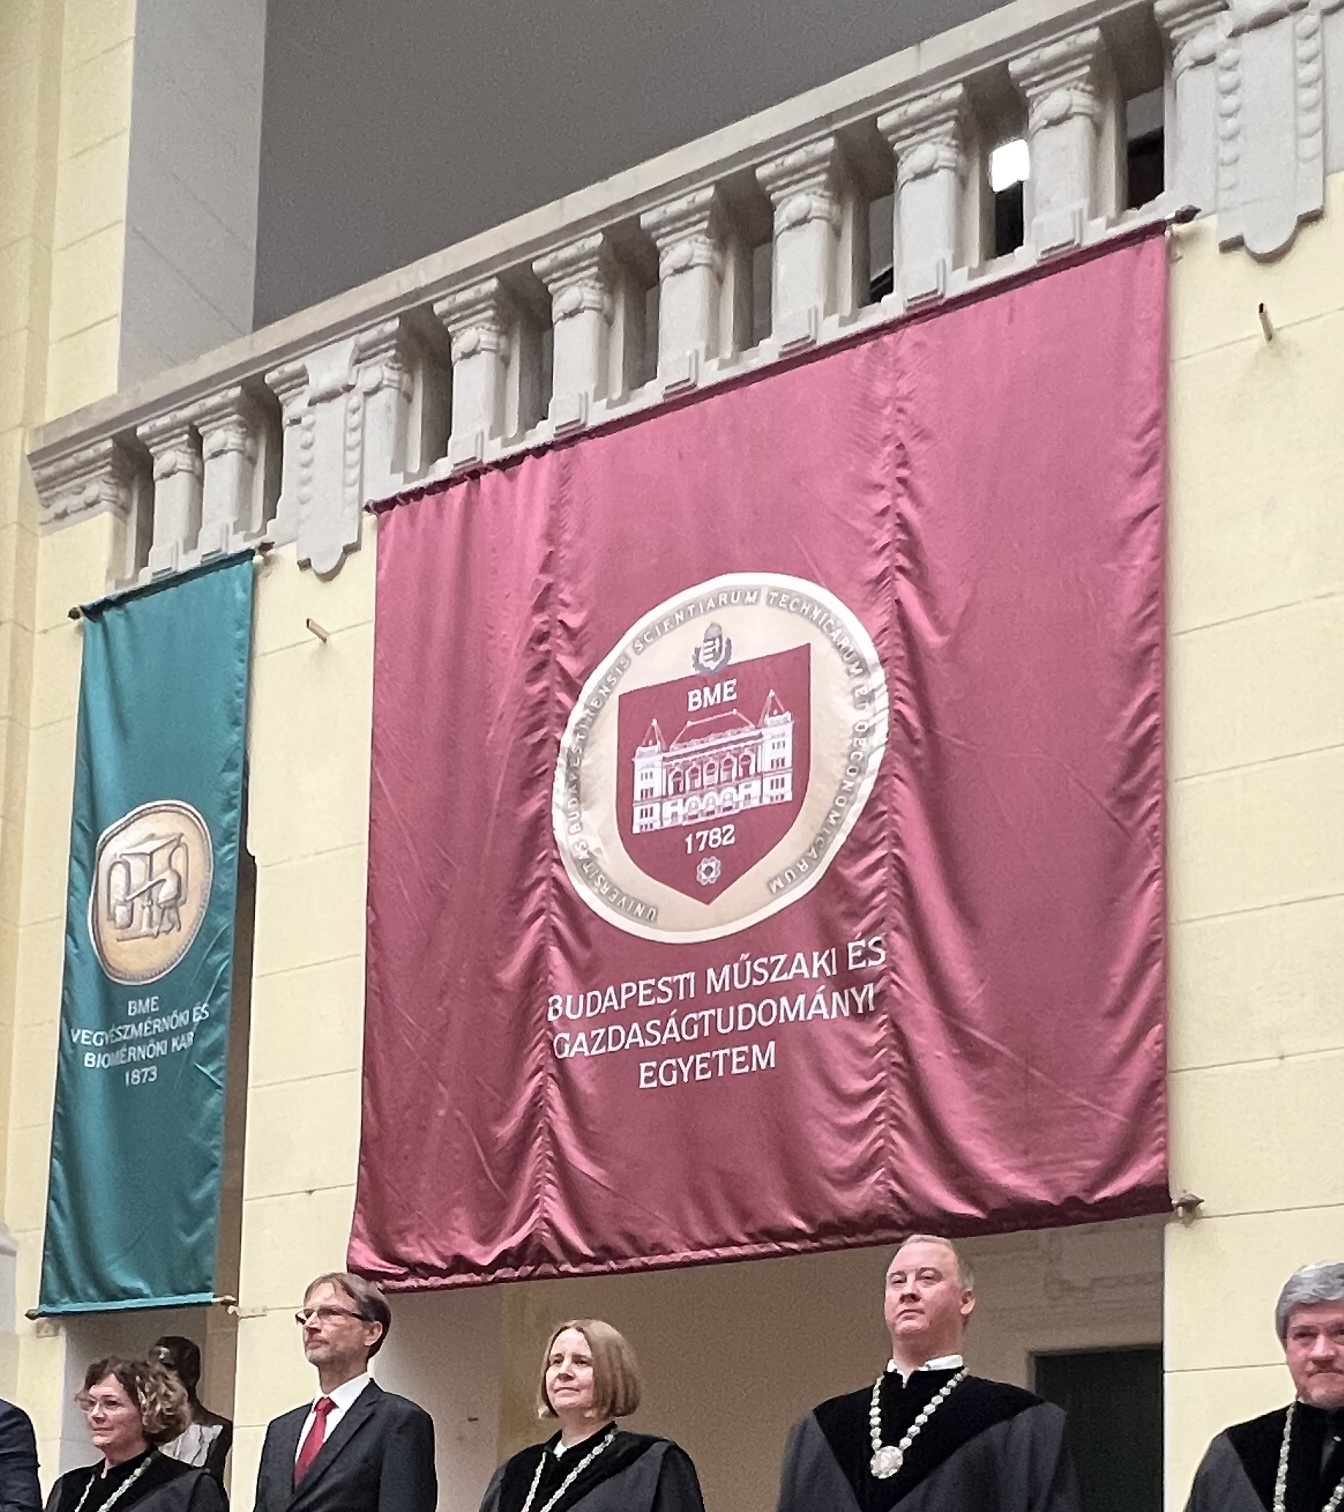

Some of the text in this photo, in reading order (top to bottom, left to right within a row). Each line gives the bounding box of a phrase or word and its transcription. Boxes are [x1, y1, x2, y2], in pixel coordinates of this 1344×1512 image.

[688, 679, 737, 712] BME
[574, 840, 657, 921] UNIVERSITAS
[634, 591, 758, 651] SCIENTIARUM
[769, 592, 863, 676] TECHNICARUM
[685, 824, 735, 854] 1782
[547, 932, 887, 1022] BUDAPESTI MŰSZAKI ÉS
[128, 996, 159, 1016] BME
[192, 1002, 209, 1023] ÉS
[553, 982, 875, 1059] GAZDASÁGTUDOMÁNYI
[172, 1031, 196, 1053] KAR
[125, 1066, 158, 1088] 1873
[639, 1040, 776, 1089] EGYETEM
